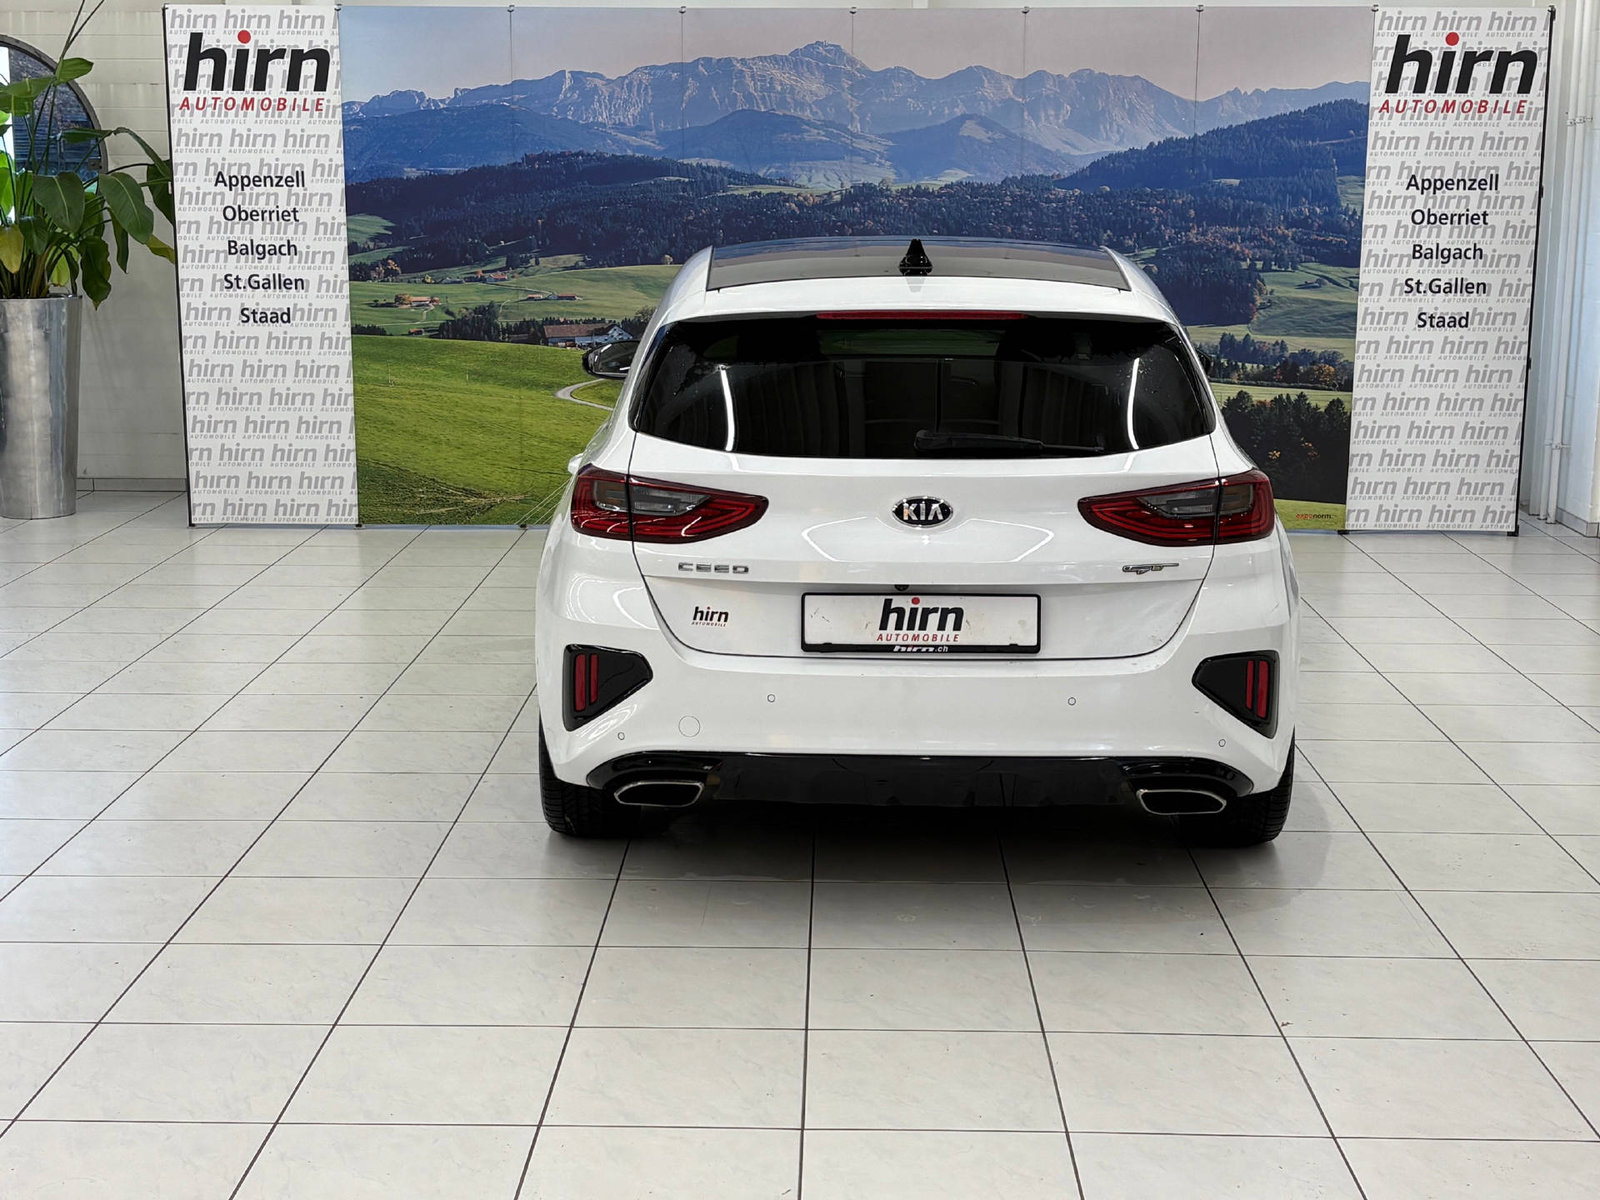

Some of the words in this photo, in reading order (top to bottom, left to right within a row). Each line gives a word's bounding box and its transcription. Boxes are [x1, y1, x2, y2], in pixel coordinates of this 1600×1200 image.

[170, 9, 216, 29] hirn
[224, 9, 270, 29] hirn
[279, 10, 324, 29] hirn
[1378, 11, 1426, 31] hirn
[1433, 11, 1481, 31] hirn
[1488, 12, 1536, 31] hirn
[184, 30, 330, 92] hirn
[1385, 32, 1538, 94] hirn
[179, 97, 325, 112] AUTOMOBILE
[1379, 100, 1527, 114] AUTOMOBILE
[176, 128, 222, 147] hirn
[230, 129, 276, 147] hirn
[284, 129, 330, 147] hirn
[1372, 131, 1419, 150] hirn
[1426, 132, 1474, 150] hirn
[1481, 132, 1528, 151] hirn
[174, 161, 197, 176] rn
[312, 159, 345, 177] hir
[1367, 164, 1390, 179] rn
[1506, 162, 1538, 180] hir
[214, 171, 305, 191] Appenzell
[1406, 174, 1499, 195] Appenzell
[180, 187, 225, 205] hirn
[286, 188, 332, 206] hirn
[1368, 191, 1415, 209] hirn
[1477, 192, 1524, 210] hirn
[223, 205, 299, 222] Oberriet
[1411, 209, 1489, 225] Oberriet
[178, 220, 200, 234] rn
[315, 217, 348, 235] hir
[1364, 223, 1387, 238] rn
[1502, 221, 1534, 239] hir
[183, 245, 228, 263] hirn
[227, 240, 298, 260] Balgach
[1365, 249, 1412, 267] hirn
[1411, 243, 1484, 263] Balgach
[181, 277, 203, 292] rn
[317, 275, 350, 293] hir
[224, 274, 305, 290] St.Gallen
[1361, 281, 1383, 296] rn
[1498, 279, 1530, 297] hir
[1404, 277, 1487, 295] St.Gallen
[186, 302, 231, 320] hirn
[292, 303, 337, 321] hirn
[240, 308, 292, 324] Staad
[1361, 307, 1408, 325] hirn
[1469, 308, 1516, 326] hirn
[1417, 312, 1470, 328] Staad
[184, 334, 206, 349] rn
[214, 331, 259, 349] hirn
[267, 332, 312, 349] hirn
[320, 332, 352, 350] hir
[1357, 339, 1379, 353] rn
[1387, 336, 1433, 354] hirn
[1440, 336, 1488, 354] hirn
[1494, 337, 1526, 354] hir
[189, 359, 234, 377] hirn
[241, 360, 287, 377] hirn
[294, 360, 339, 378] hirn
[1358, 364, 1404, 382] hirn
[1412, 365, 1458, 383] hirn
[1465, 365, 1512, 383] hirn
[186, 391, 209, 405] rn
[217, 388, 262, 405] hirn
[269, 388, 314, 406] hirn
[322, 388, 354, 406] hir
[1354, 396, 1375, 410] rn
[1383, 393, 1429, 410] hirn
[1436, 393, 1483, 411] hirn
[1490, 394, 1523, 411] hir
[192, 415, 237, 433] hirn
[244, 416, 289, 433] hirn
[297, 416, 341, 434] hirn
[1354, 421, 1400, 439] hirn
[1408, 421, 1454, 439] hirn
[1461, 422, 1508, 440] hirn
[189, 446, 212, 460] rn
[220, 443, 264, 461] hirn
[272, 444, 317, 461] hirn
[324, 444, 356, 462] hir
[1351, 452, 1372, 466] rn
[1379, 449, 1426, 467] hirn
[1433, 449, 1479, 467] hirn
[1486, 450, 1519, 468] hir
[195, 470, 239, 488] hirn
[247, 471, 291, 489] hirn
[299, 471, 344, 489] hirn
[1351, 477, 1396, 494] hirn
[1404, 477, 1450, 495] hirn
[1457, 478, 1504, 495] hirn
[192, 501, 215, 515] rn
[222, 498, 267, 516] hirn
[275, 499, 319, 516] hirn
[327, 499, 359, 517] hir
[902, 501, 943, 520] KIA
[1348, 508, 1368, 522] rn
[1375, 505, 1422, 522] hirn
[1428, 505, 1475, 523] hirn
[1482, 505, 1515, 523] hir
[678, 562, 749, 574] CEED
[692, 606, 729, 623] hirn
[879, 597, 964, 631] hirn
[877, 633, 960, 642] AUTOMOBILE
